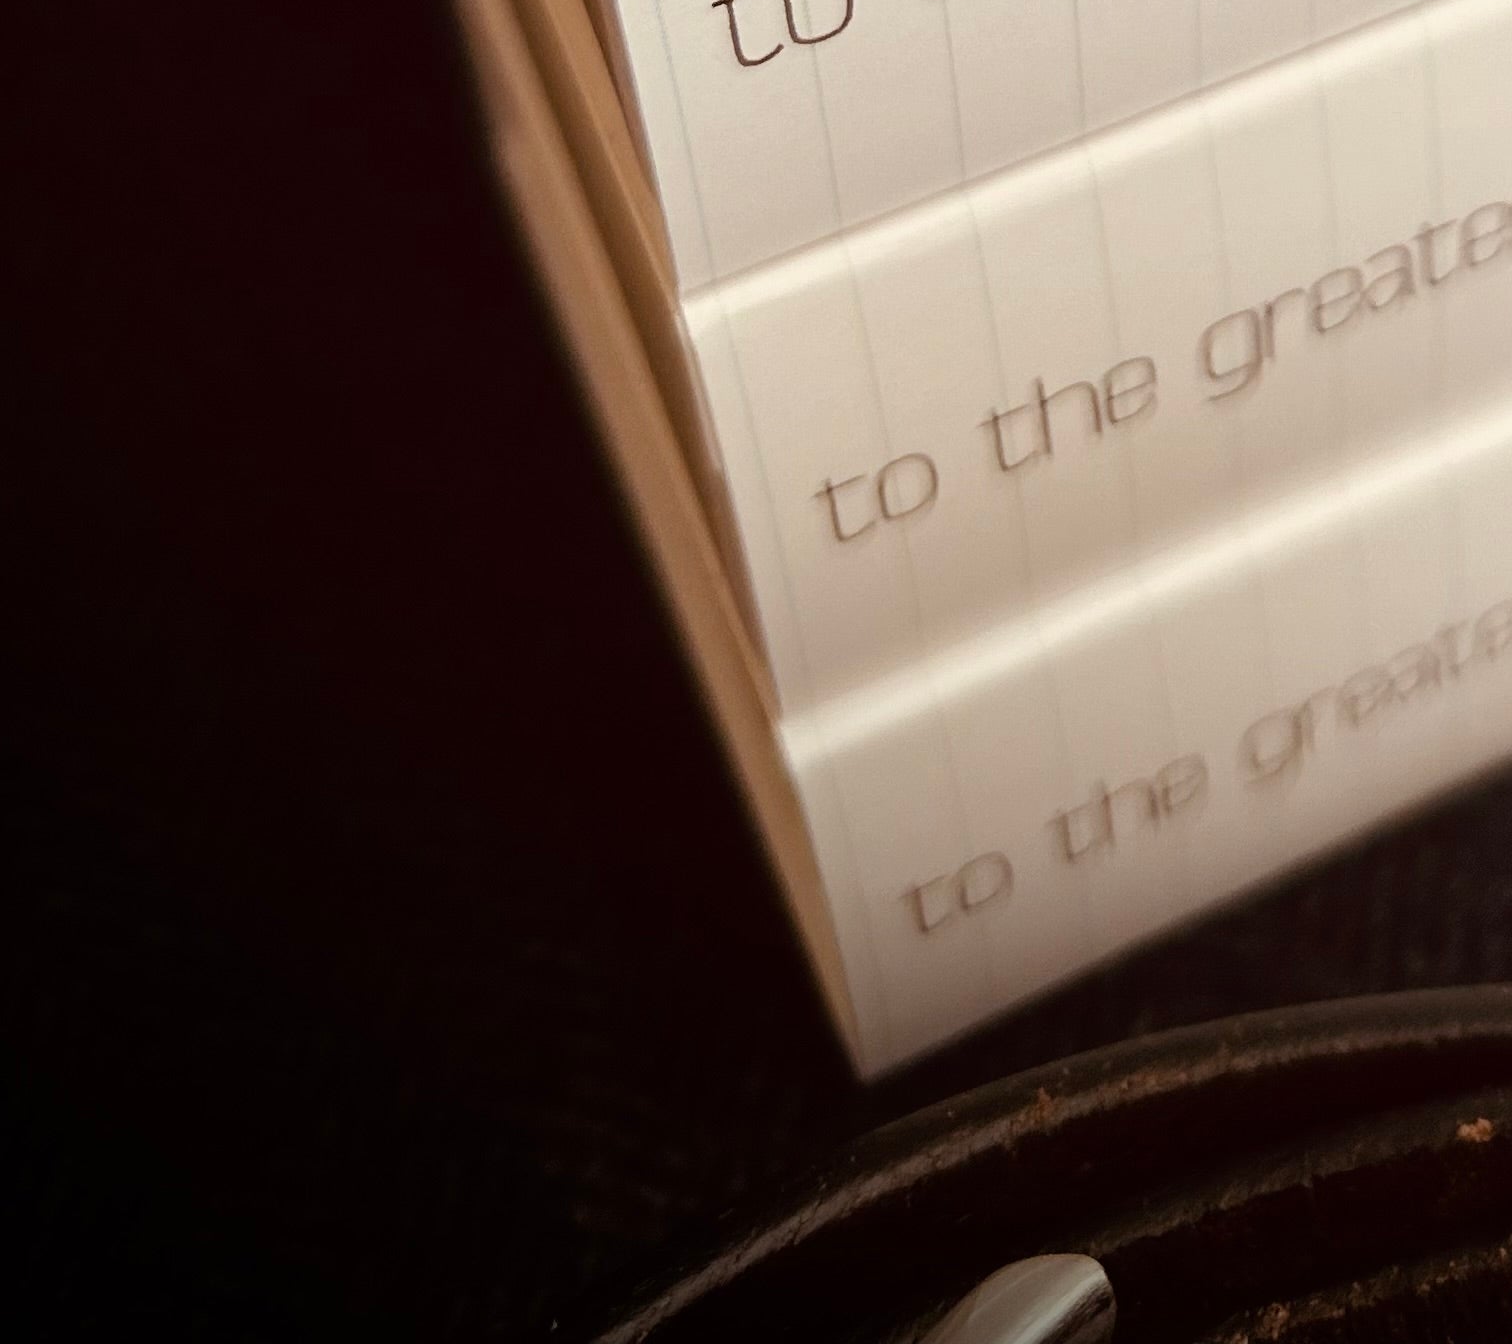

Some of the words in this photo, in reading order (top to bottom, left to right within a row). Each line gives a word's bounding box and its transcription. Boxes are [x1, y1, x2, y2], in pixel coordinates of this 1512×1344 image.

[814, 452, 939, 543] to
[980, 354, 1158, 474] the
[900, 851, 1014, 936] to
[1047, 752, 1209, 863] the
